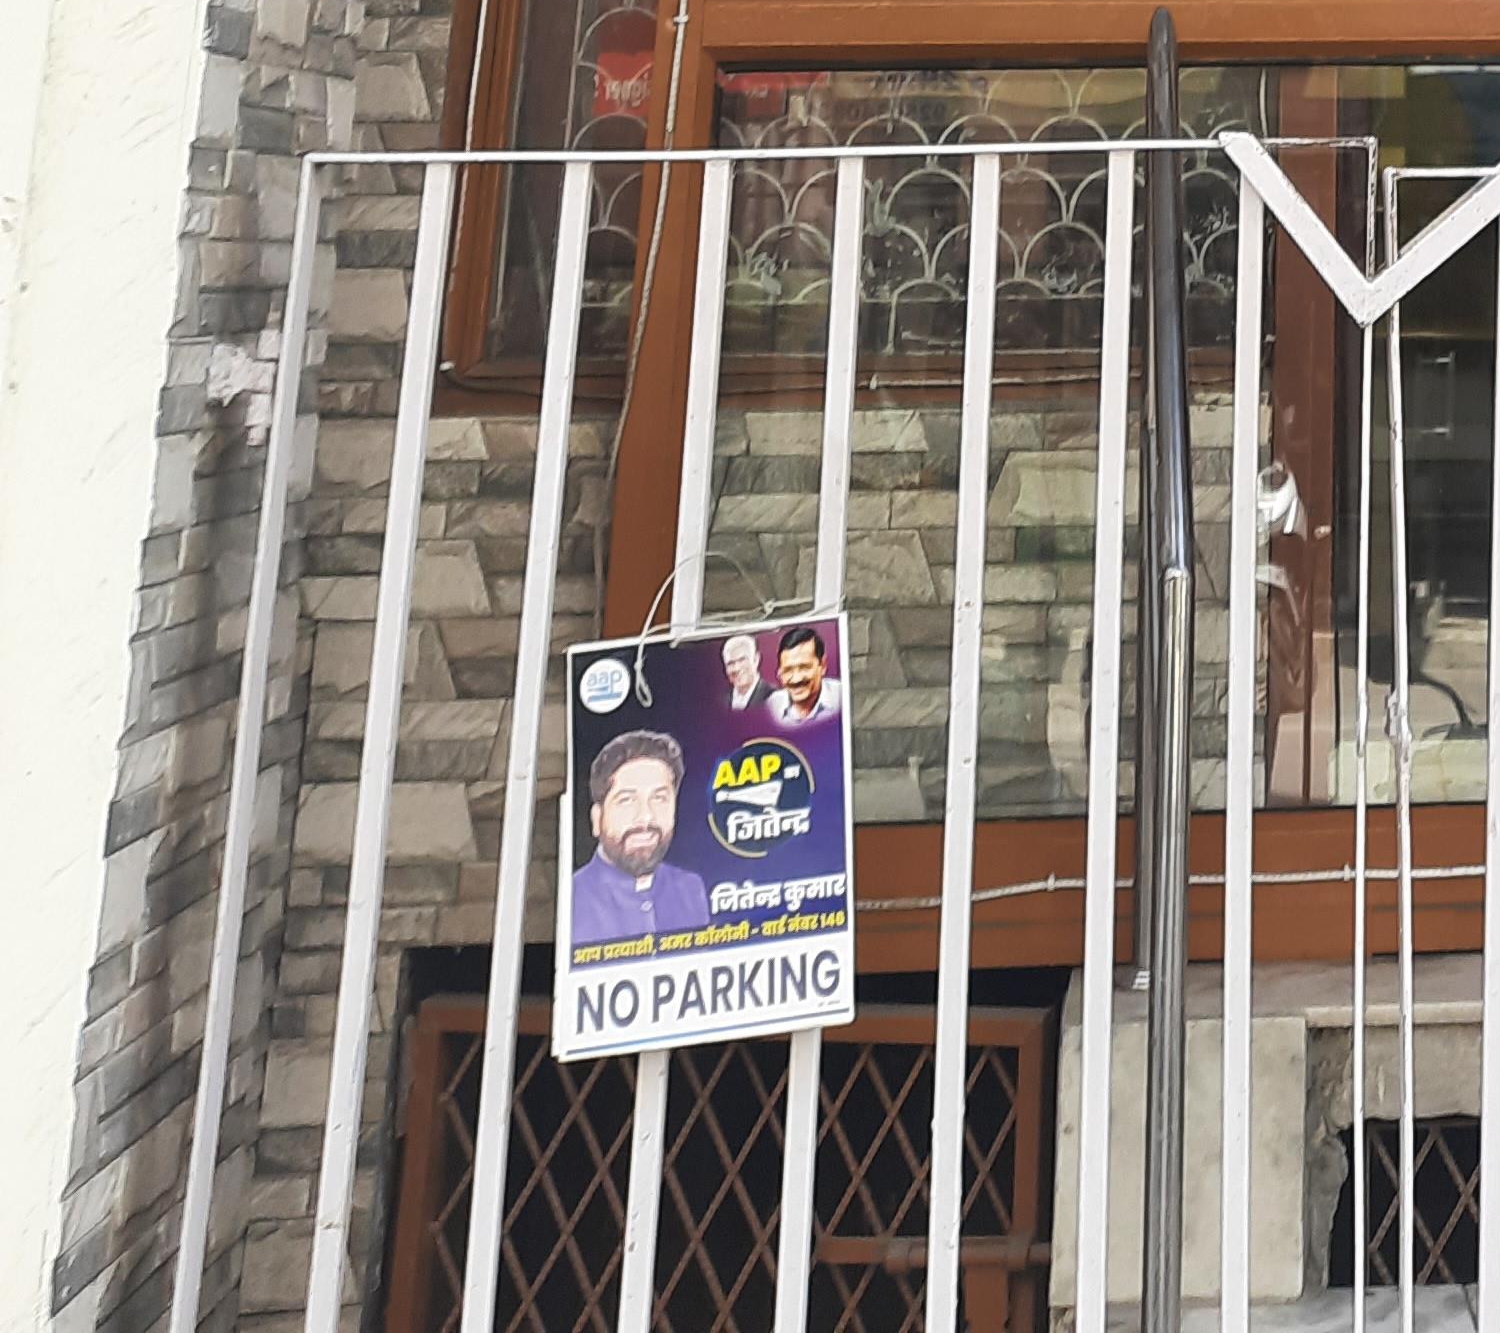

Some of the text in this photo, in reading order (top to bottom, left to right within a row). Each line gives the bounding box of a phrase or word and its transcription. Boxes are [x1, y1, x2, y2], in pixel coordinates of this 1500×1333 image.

[712, 754, 782, 791] AAP
[783, 872, 846, 912] कुमार
[575, 948, 841, 1035] NO PARKING
